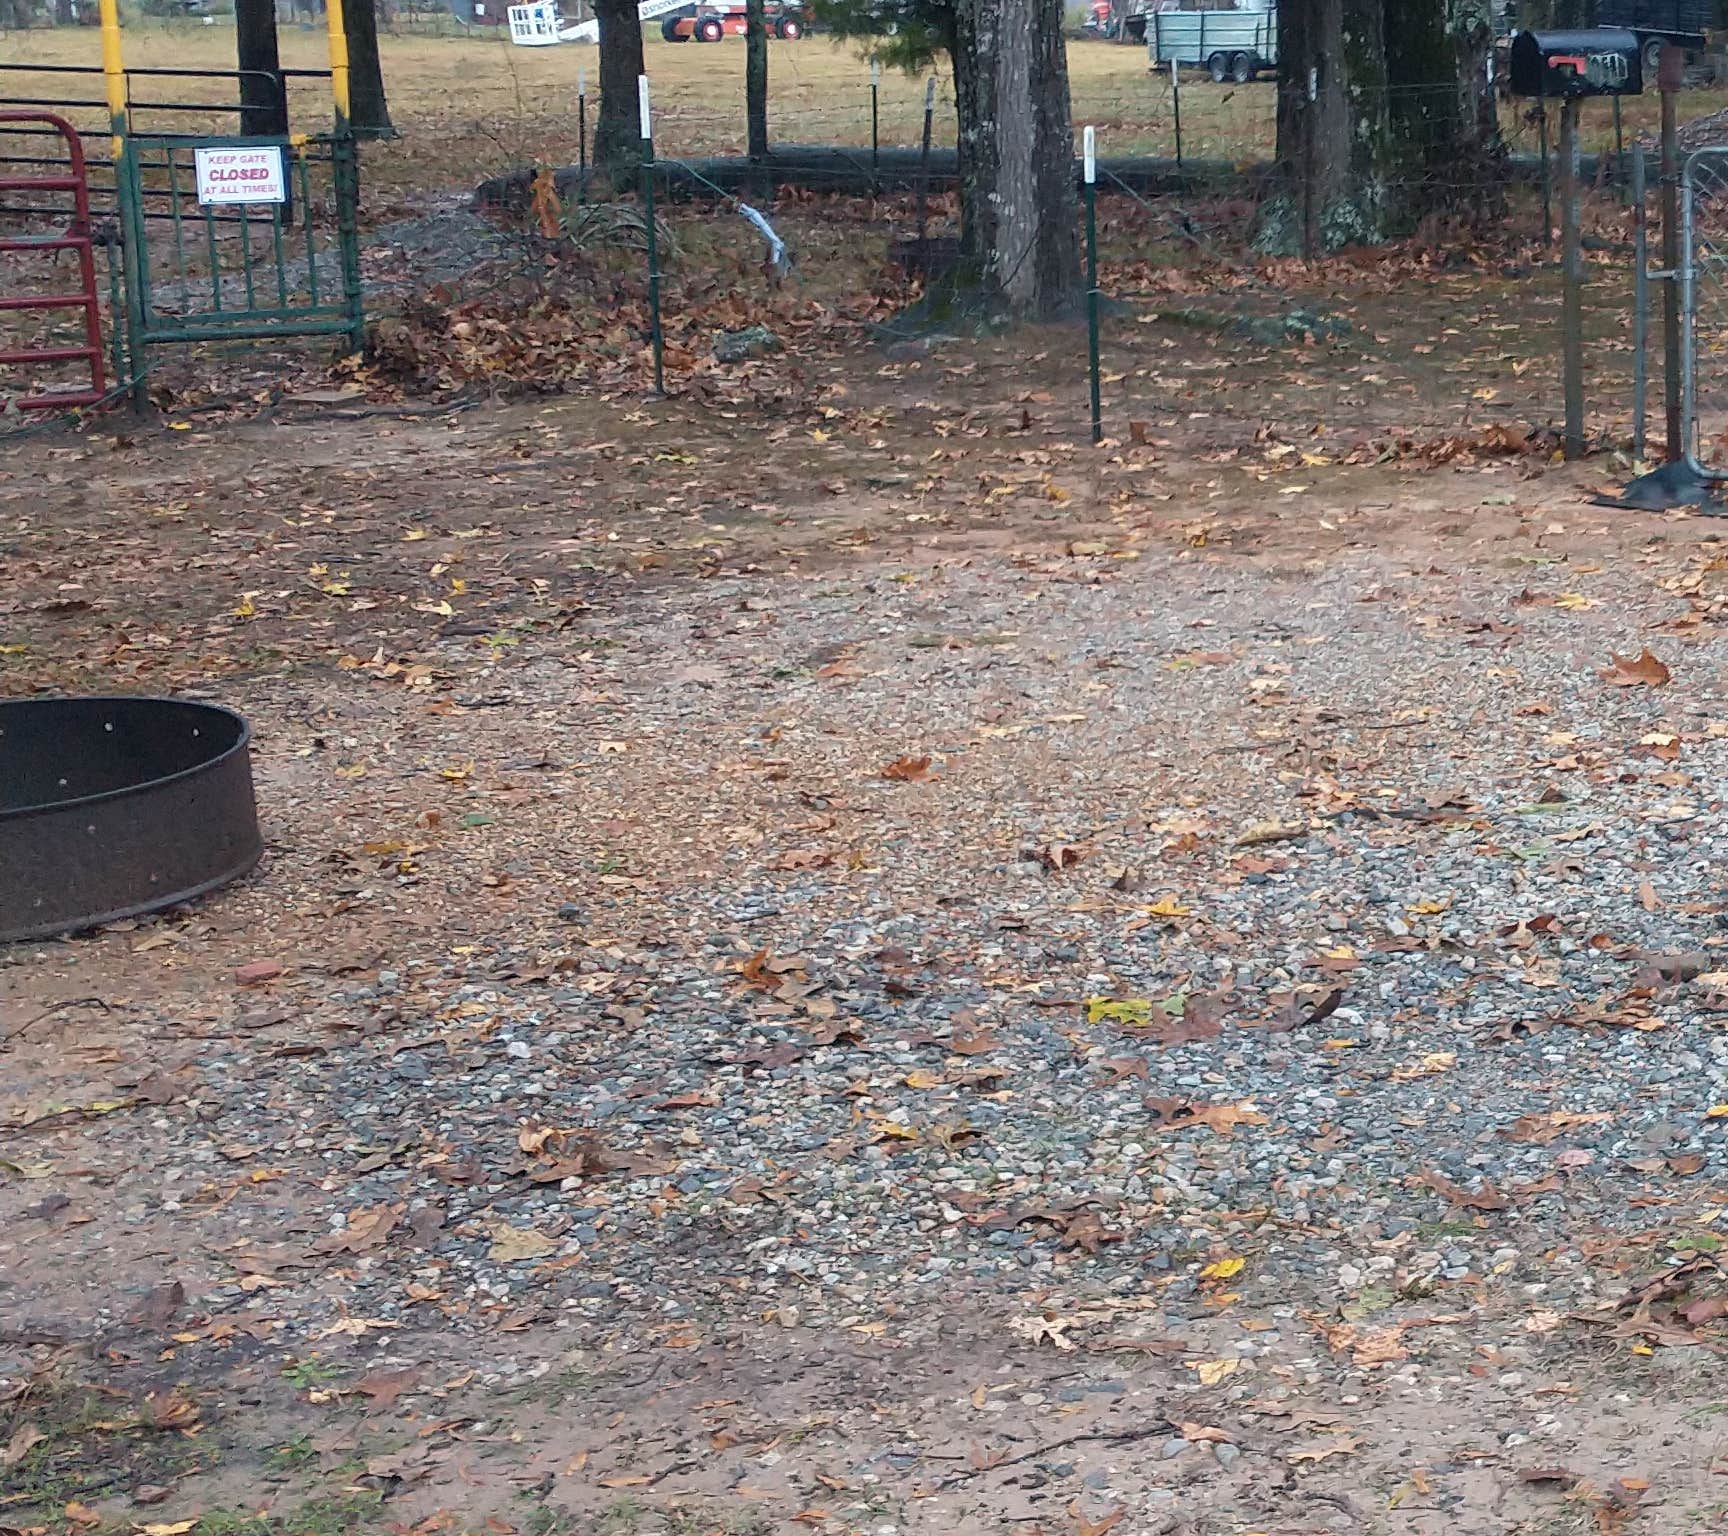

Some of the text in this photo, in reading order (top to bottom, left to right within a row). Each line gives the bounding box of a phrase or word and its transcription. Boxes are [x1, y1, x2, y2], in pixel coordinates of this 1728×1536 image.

[208, 154, 267, 164] KEEP GATE
[209, 168, 269, 181] CLOSED
[204, 186, 216, 195] AT
[219, 185, 239, 194] ALL
